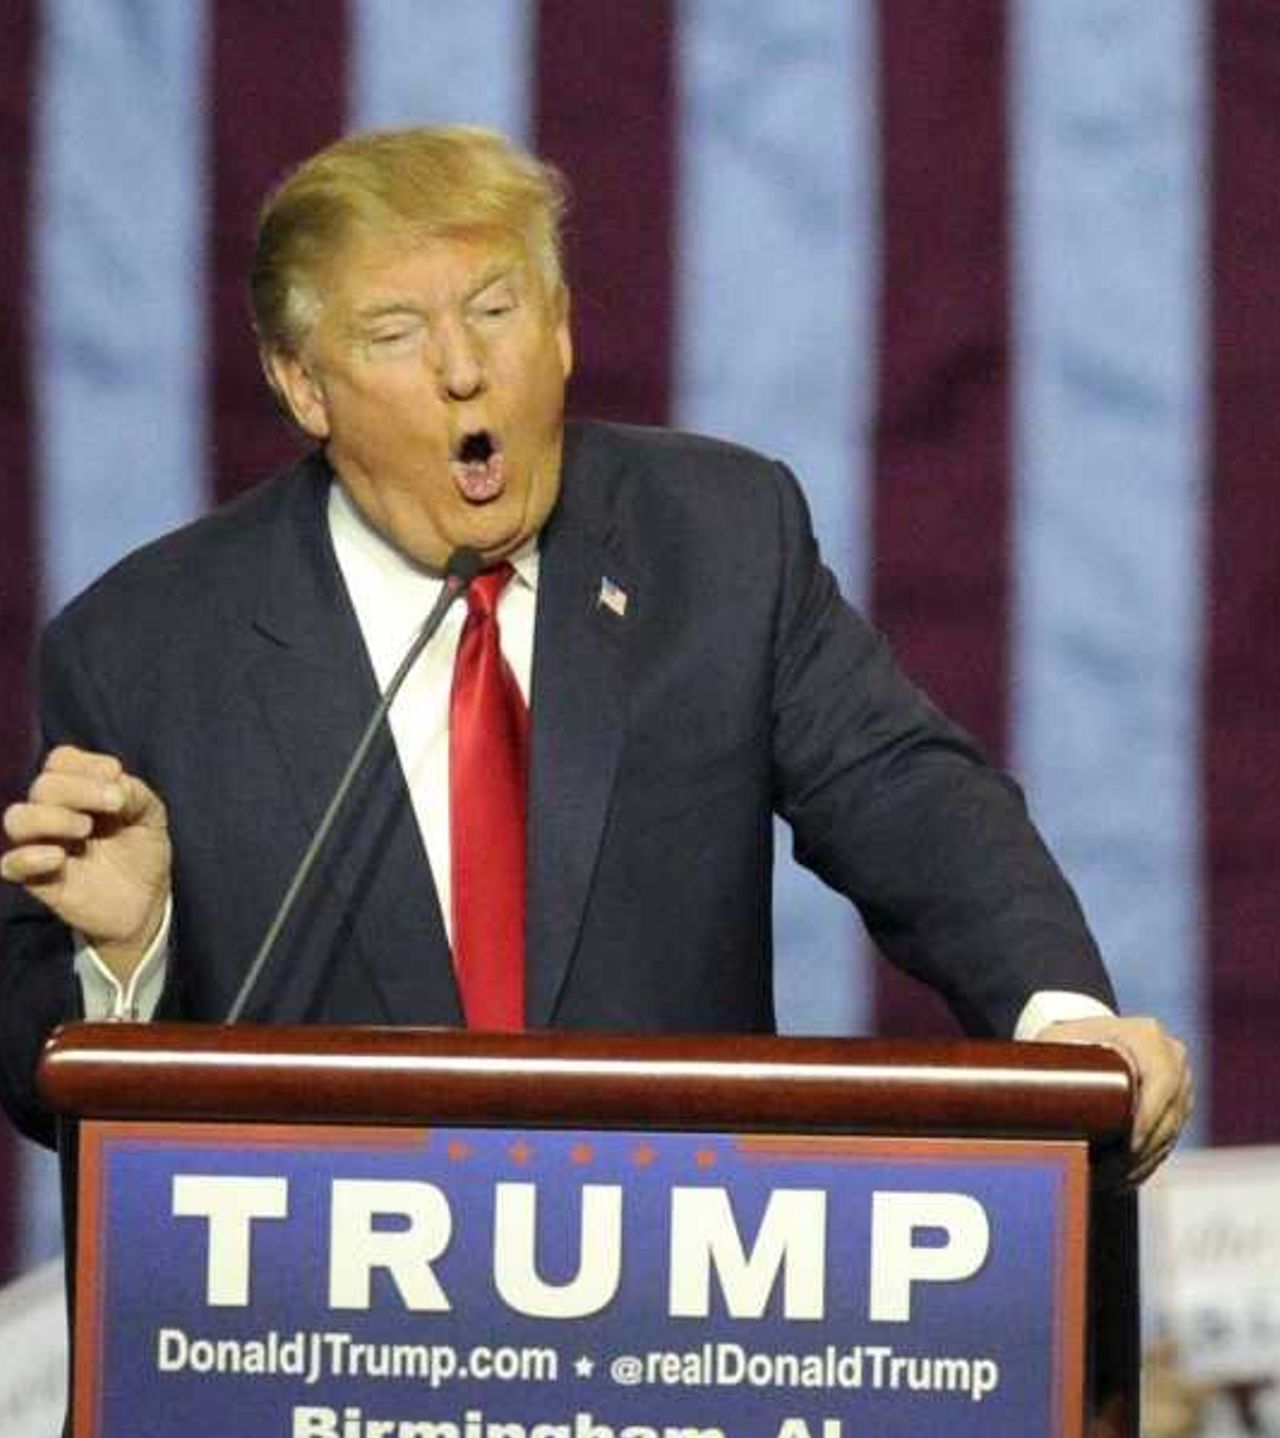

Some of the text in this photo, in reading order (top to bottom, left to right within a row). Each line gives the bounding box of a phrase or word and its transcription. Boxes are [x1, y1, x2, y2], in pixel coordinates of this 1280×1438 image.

[171, 1173, 993, 1324] TRUMP
[156, 1328, 1000, 1400] DonaldJTrump.com @realDonaldTrump
